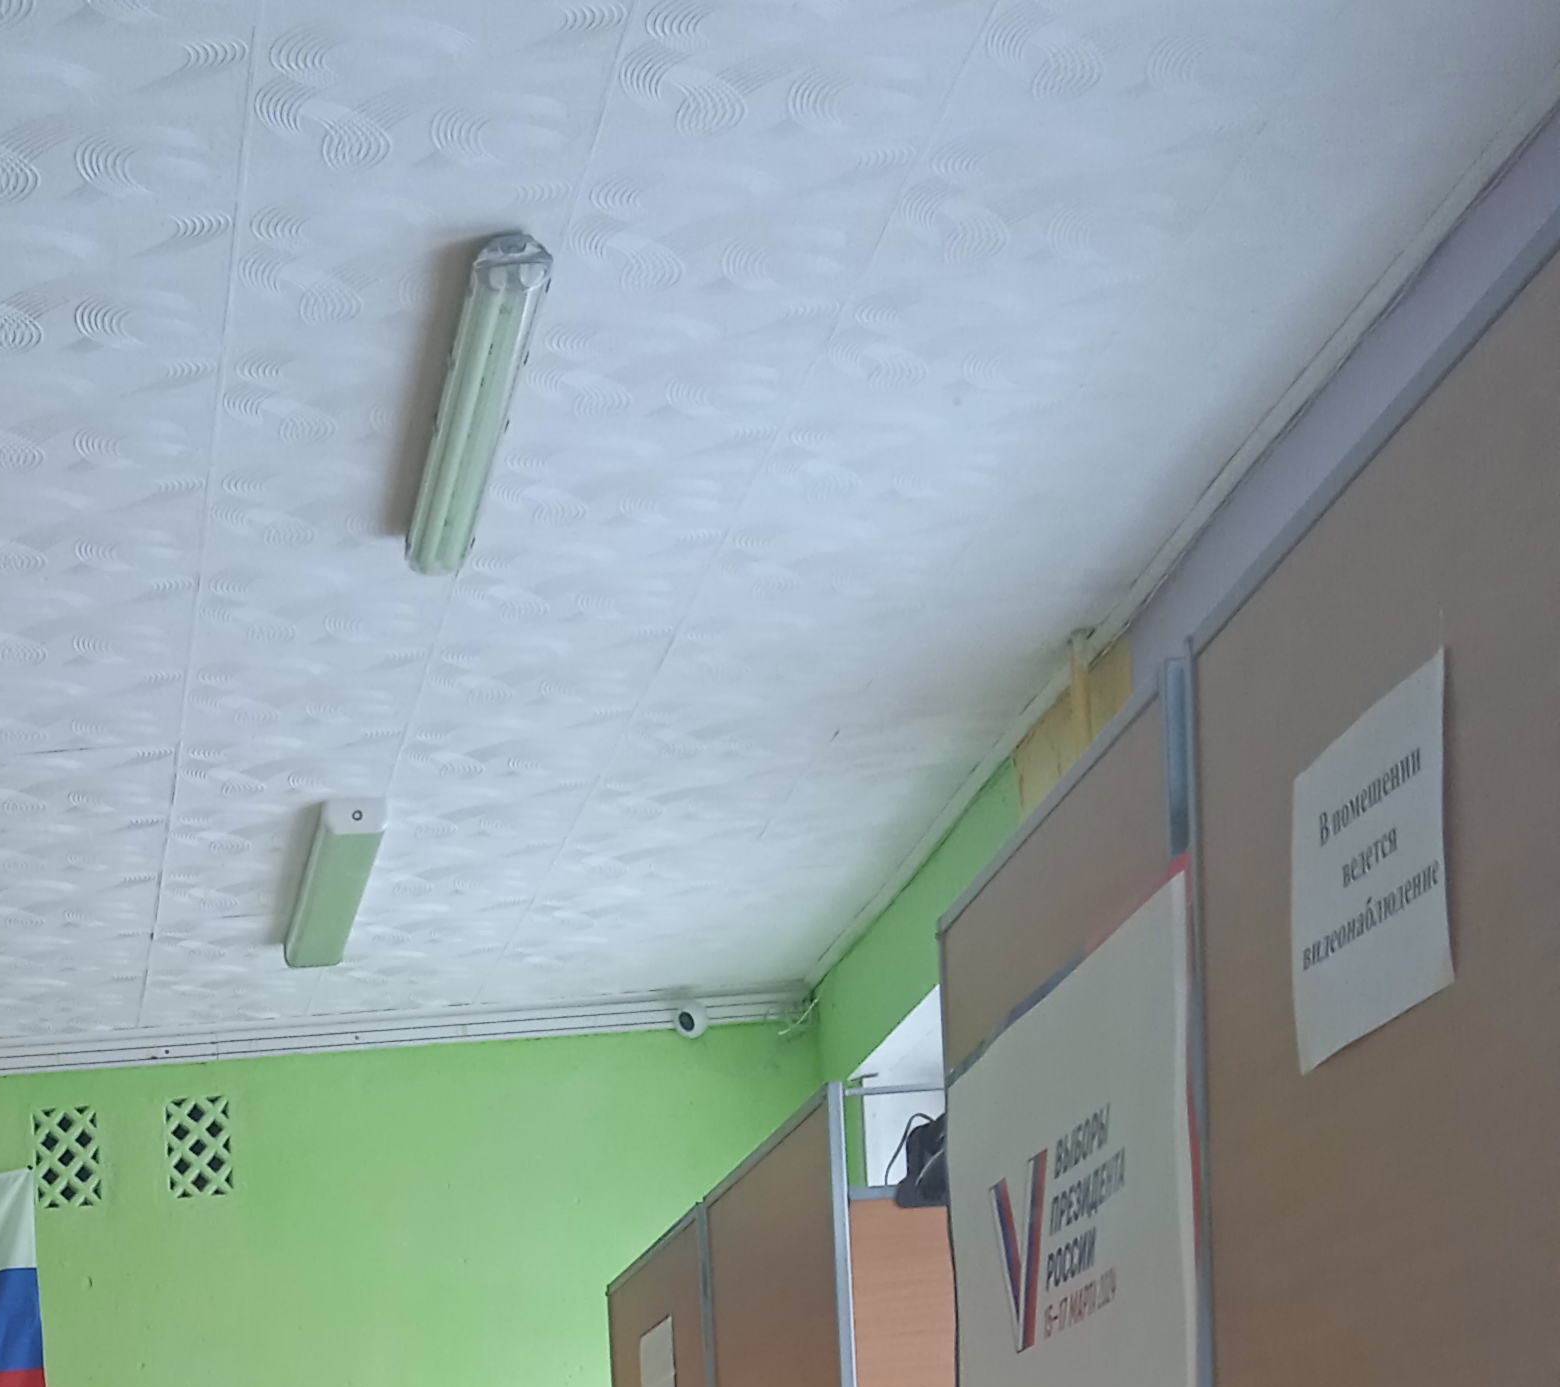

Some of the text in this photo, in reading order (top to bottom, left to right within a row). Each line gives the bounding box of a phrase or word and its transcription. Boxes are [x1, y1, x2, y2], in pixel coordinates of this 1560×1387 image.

[1318, 748, 1422, 847] В помещении
[1342, 827, 1398, 888] ведется
[1302, 860, 1441, 971] видеонаблюдение
[1054, 1102, 1111, 1179] ВЫБОРЫ
[1049, 1146, 1126, 1236] ПРЕЗИДЕНТА
[1046, 1226, 1096, 1292] РОССИИ
